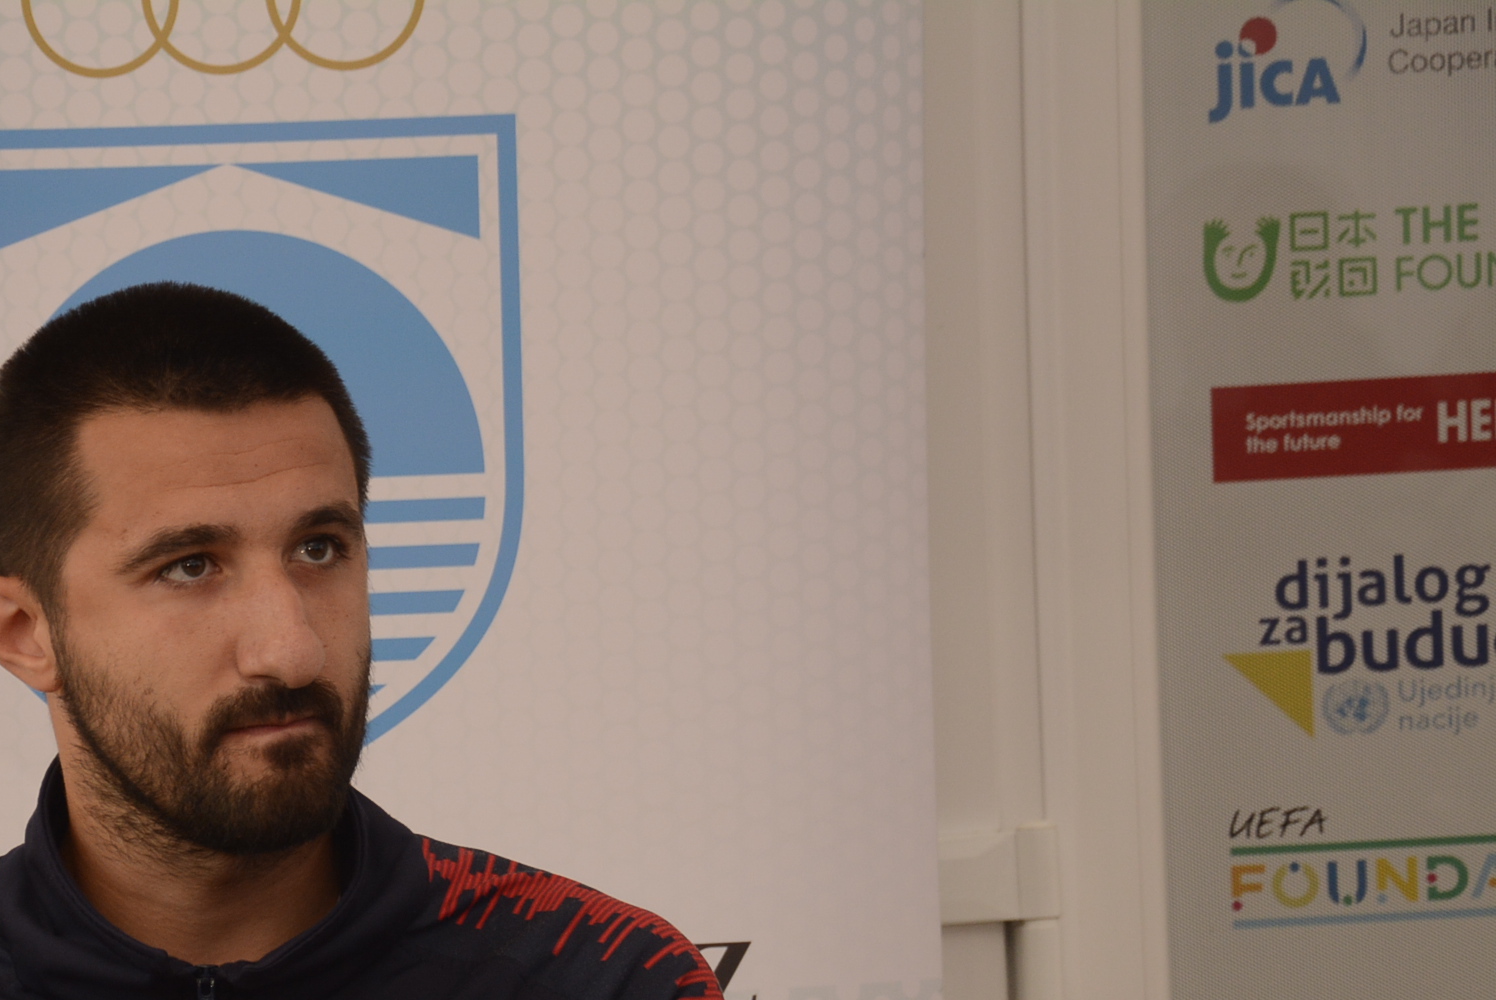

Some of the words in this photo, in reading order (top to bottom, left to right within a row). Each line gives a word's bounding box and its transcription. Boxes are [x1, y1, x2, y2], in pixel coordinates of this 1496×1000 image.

[1390, 12, 1476, 42] Japan
[1388, 47, 1496, 77] Cooper
[1394, 202, 1479, 245] THE
[1245, 403, 1392, 434] Sportsmanship
[1396, 403, 1424, 424] for
[1436, 398, 1496, 444] HE
[1245, 433, 1278, 455] the
[1282, 433, 1342, 454] future
[1275, 553, 1491, 620] dijalog
[1259, 616, 1308, 647] za
[1316, 609, 1496, 675] budu
[1399, 705, 1479, 736] nacije
[1228, 804, 1328, 840] UEFA
